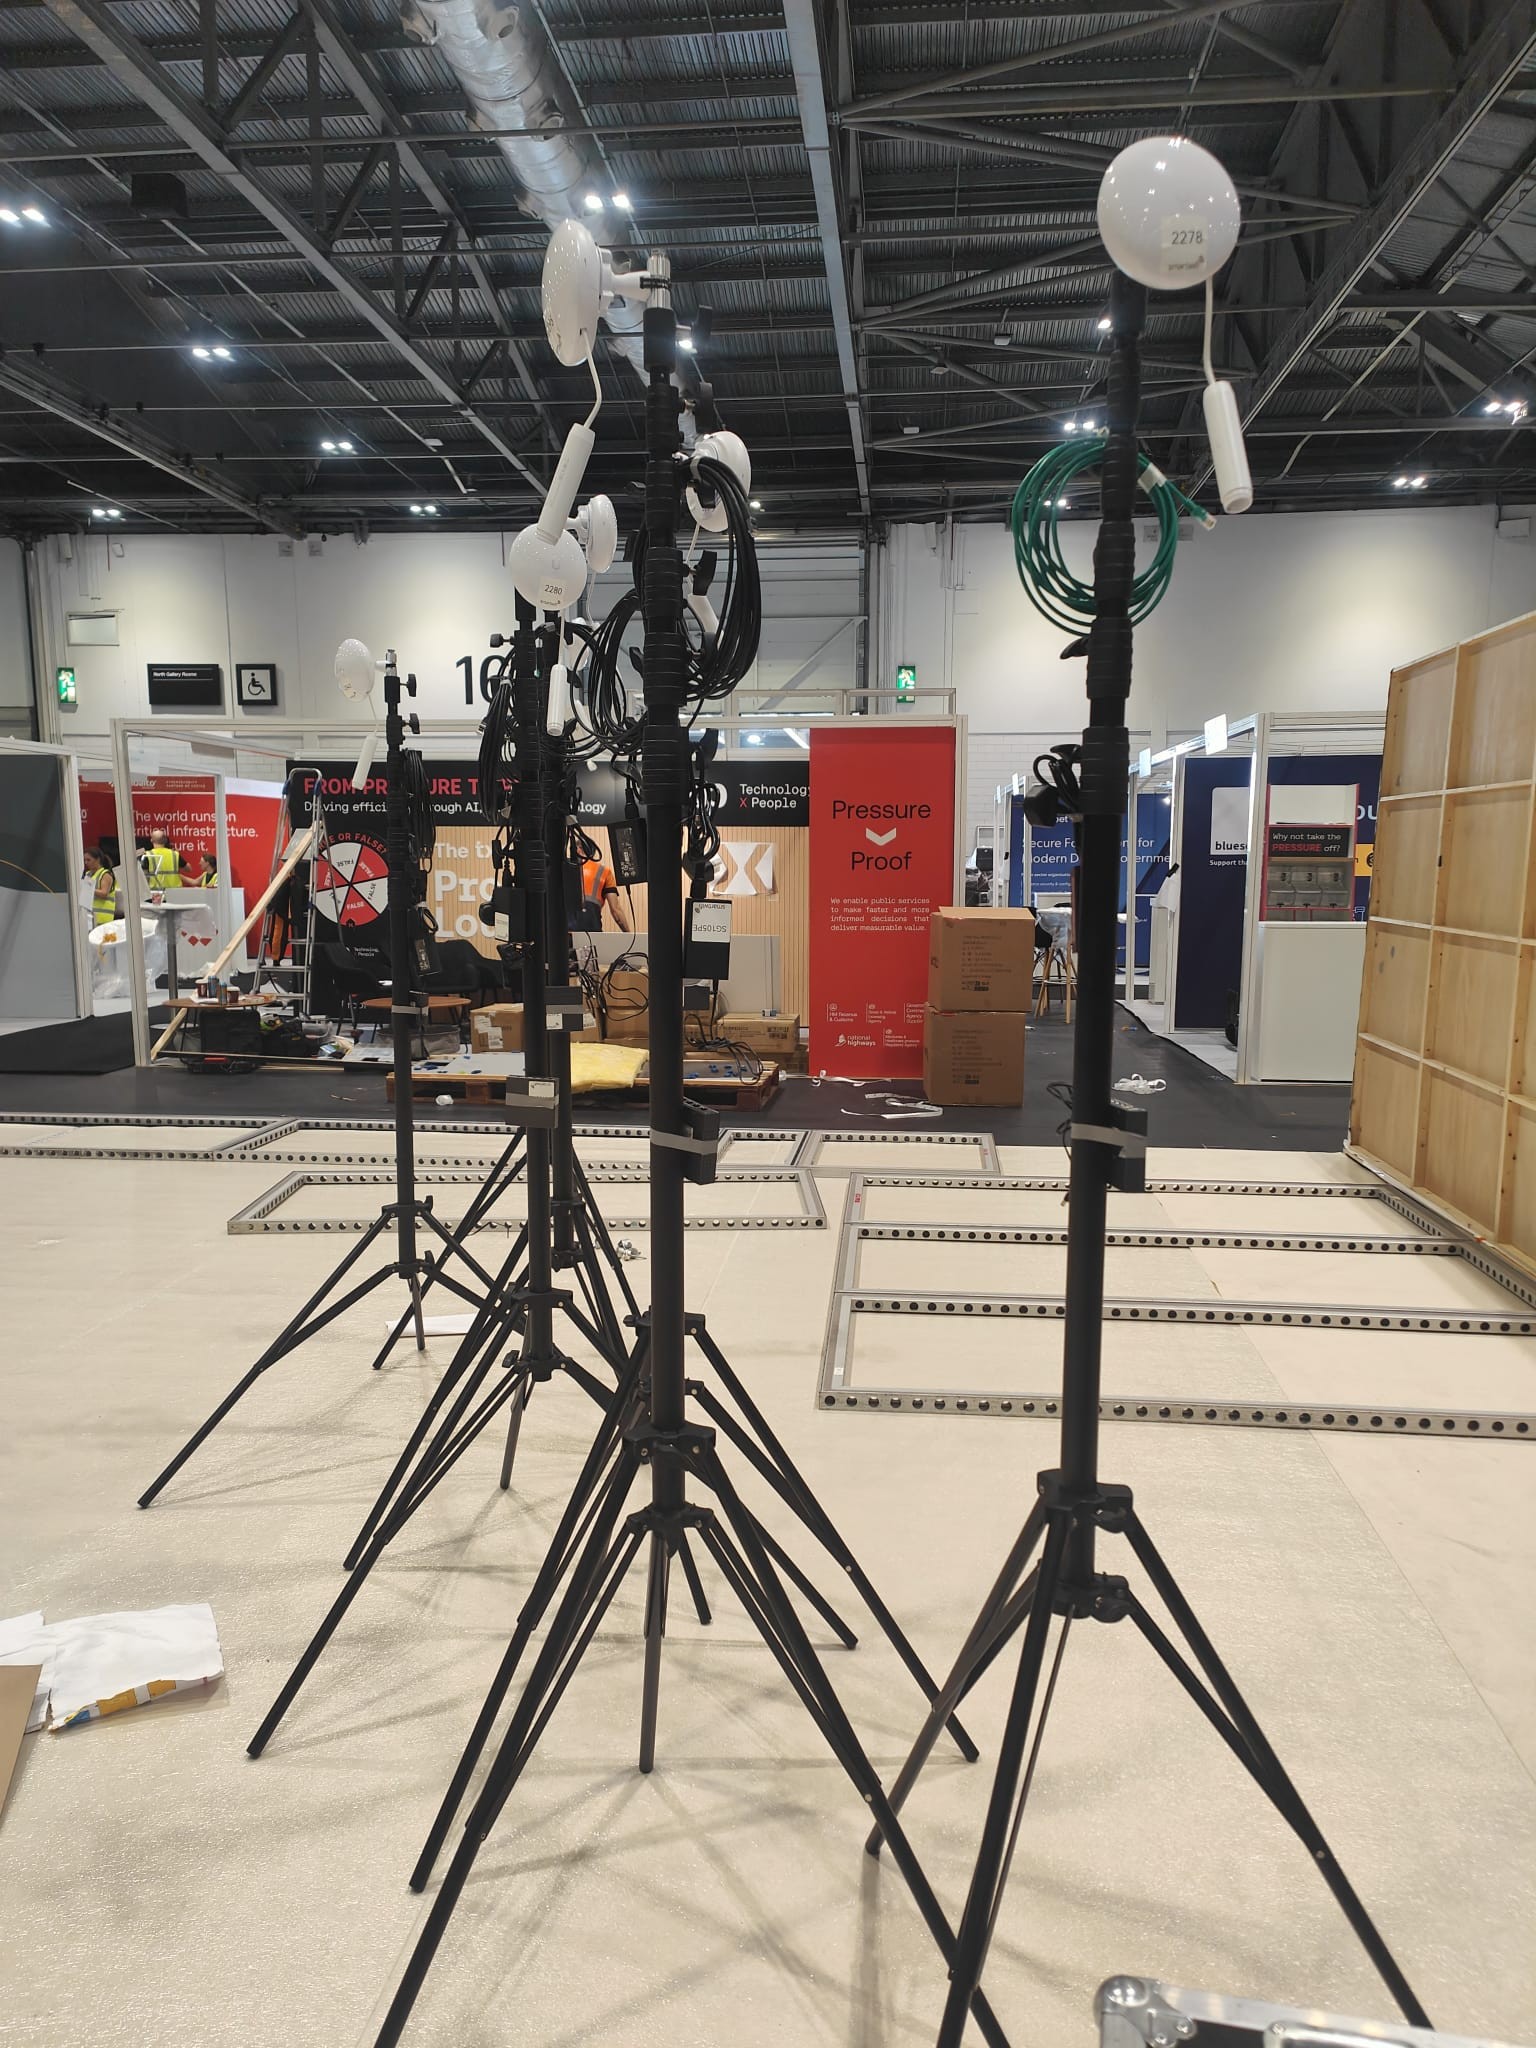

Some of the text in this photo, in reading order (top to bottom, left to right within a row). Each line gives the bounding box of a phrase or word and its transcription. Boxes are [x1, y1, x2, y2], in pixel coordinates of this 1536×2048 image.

[1171, 231, 1203, 245] 2278
[544, 585, 563, 594] 2280
[751, 797, 797, 810] People
[832, 800, 931, 819] Pressure
[153, 811, 188, 822] world
[338, 832, 351, 841] OR
[1272, 833, 1288, 842] Why
[1137, 838, 1155, 848] for
[435, 843, 469, 858] The
[1272, 844, 1322, 852] PRESSURE
[851, 851, 913, 871] Proof
[1209, 859, 1237, 868] Support
[346, 901, 365, 909] FALSE
[871, 897, 896, 905] public
[692, 924, 727, 933] SG105PE
[848, 1040, 876, 1048] highways
